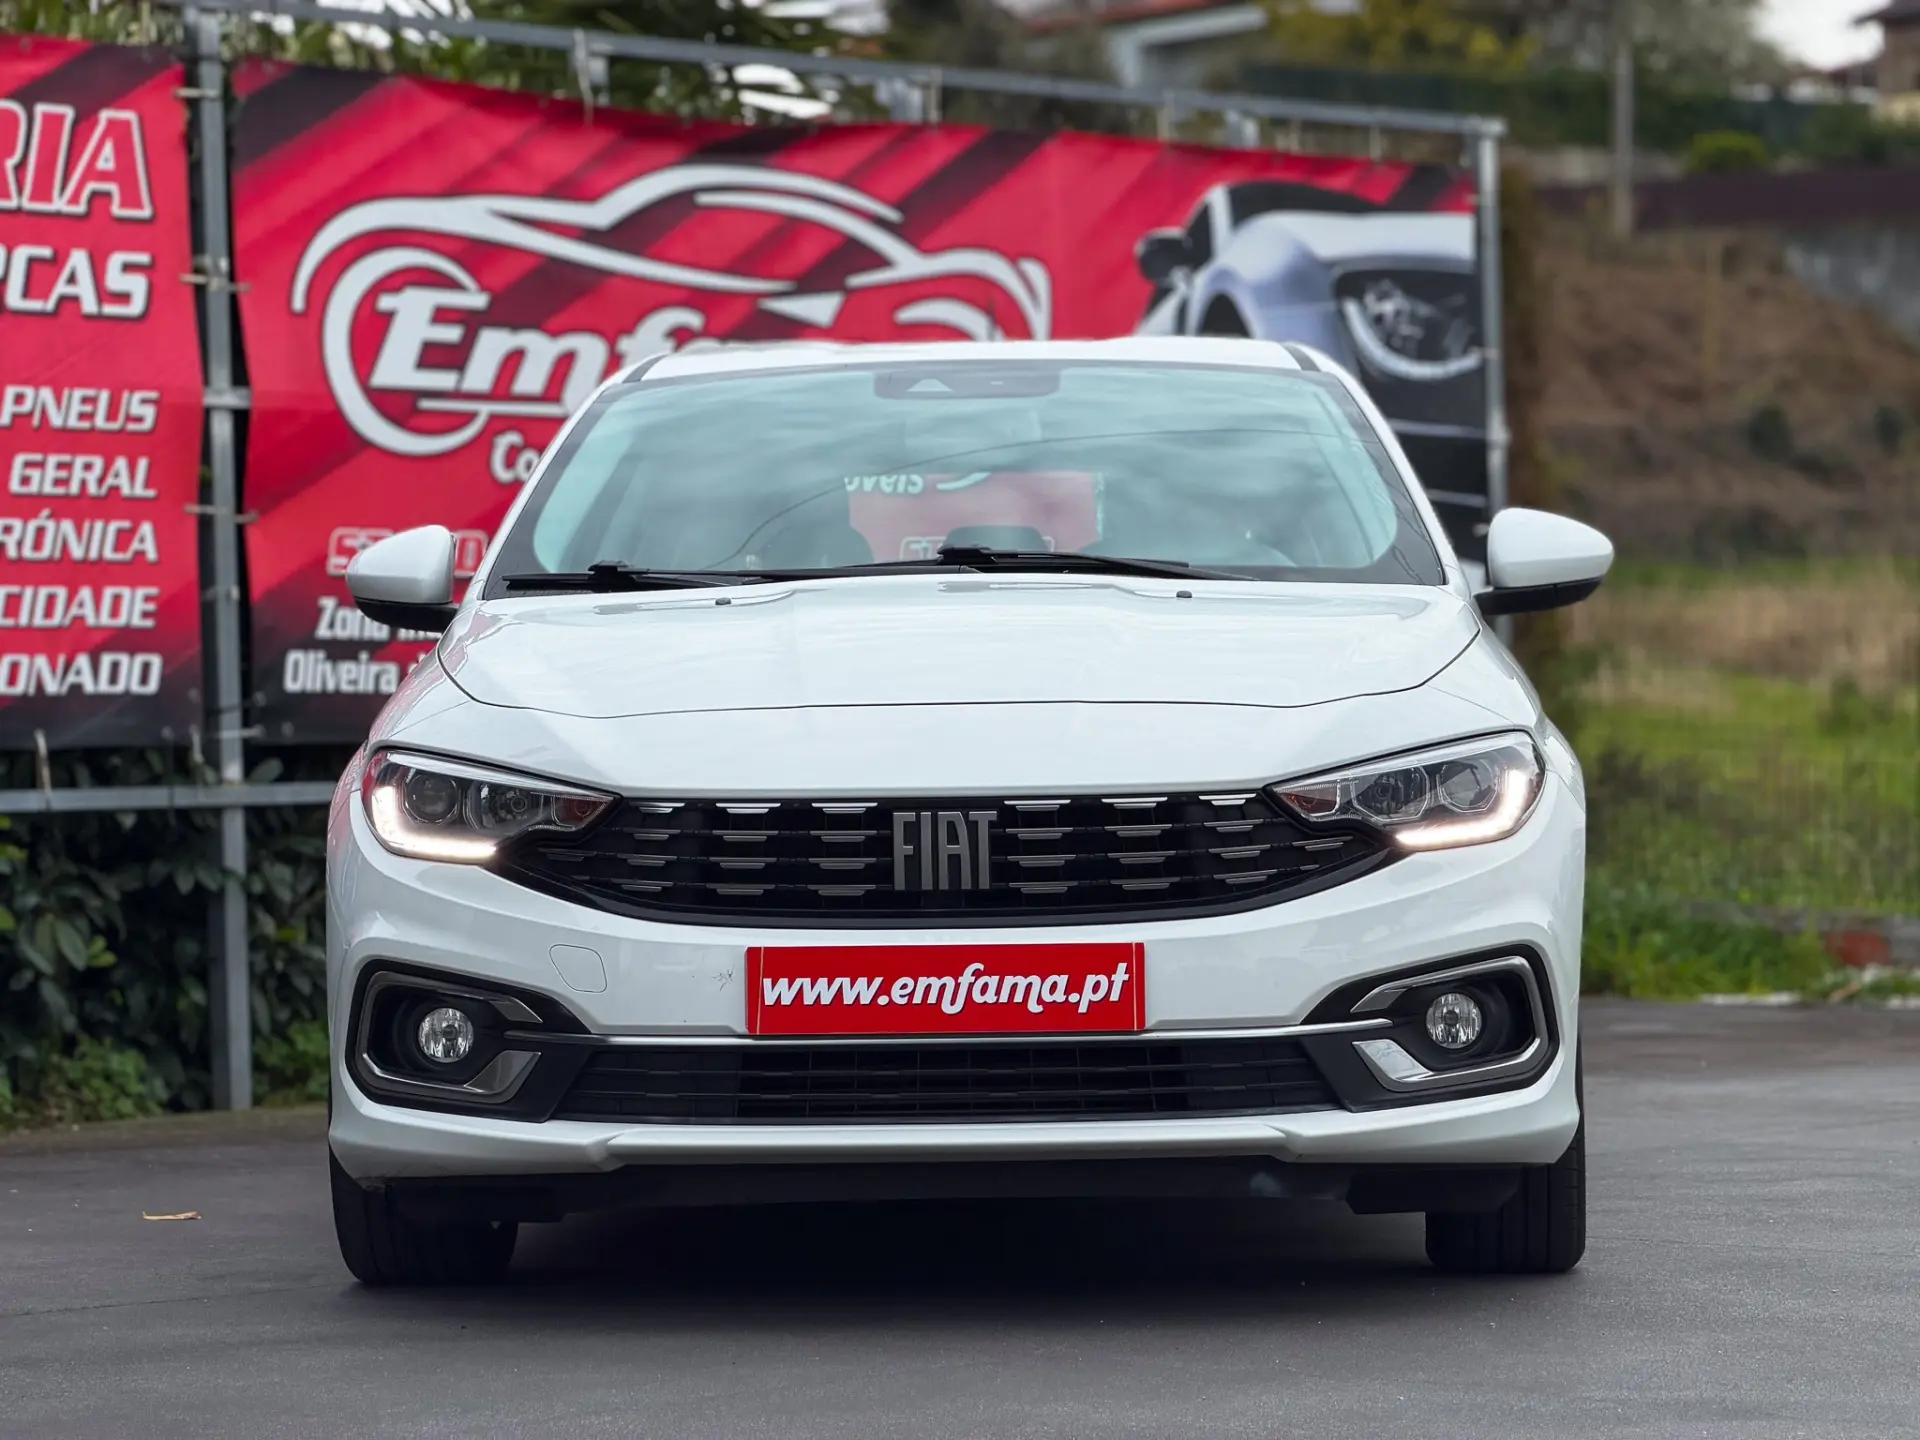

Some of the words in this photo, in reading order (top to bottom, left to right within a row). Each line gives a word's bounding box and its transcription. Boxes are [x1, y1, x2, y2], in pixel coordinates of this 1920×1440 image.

[0, 243, 152, 319] CAS
[0, 385, 158, 433] PNEUS
[9, 452, 157, 498] GERAL
[0, 652, 162, 696] ONADO
[283, 649, 400, 694] Oliveira
[893, 811, 998, 891] FIAT
[762, 962, 1130, 1015] www.emfama.pt
